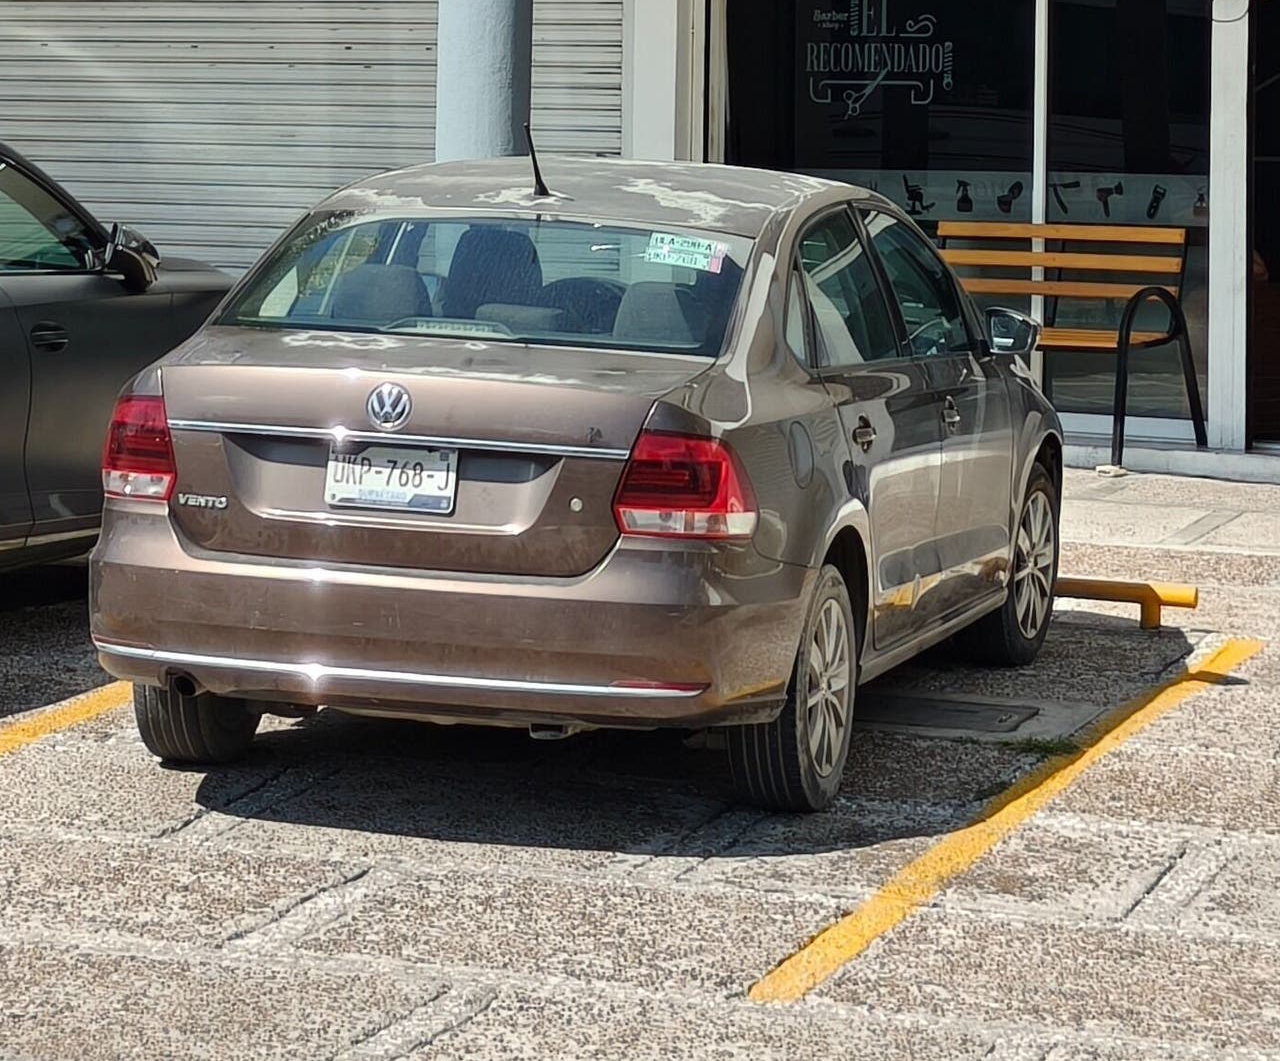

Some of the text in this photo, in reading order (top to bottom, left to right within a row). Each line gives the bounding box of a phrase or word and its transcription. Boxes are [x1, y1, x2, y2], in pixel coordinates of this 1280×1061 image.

[806, 43, 944, 74] RECOMENDADO
[333, 455, 451, 491] UKP-768-J
[178, 493, 228, 509] VENTO
